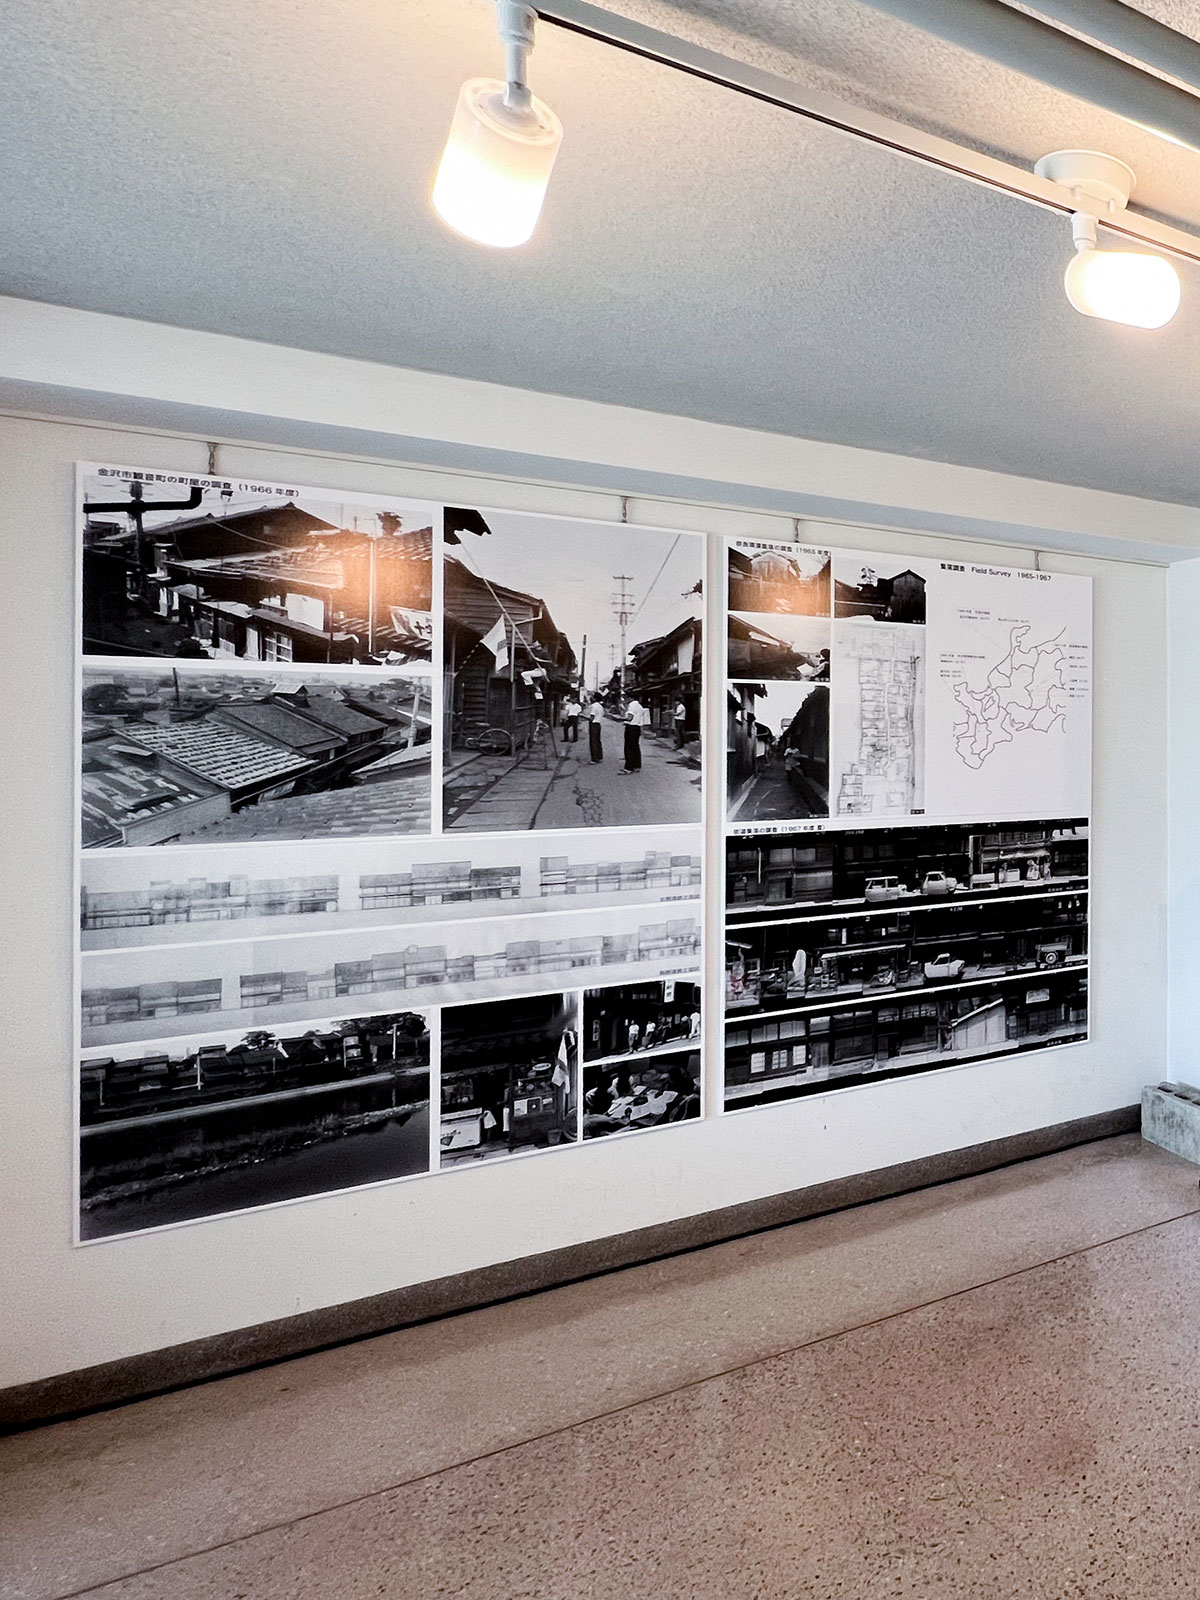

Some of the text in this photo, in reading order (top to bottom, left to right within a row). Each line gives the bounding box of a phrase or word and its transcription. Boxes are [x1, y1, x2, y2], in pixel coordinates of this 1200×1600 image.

[971, 566, 987, 575] Field
[988, 568, 1012, 578] Survey
[1017, 571, 1052, 581] 1965-1967
